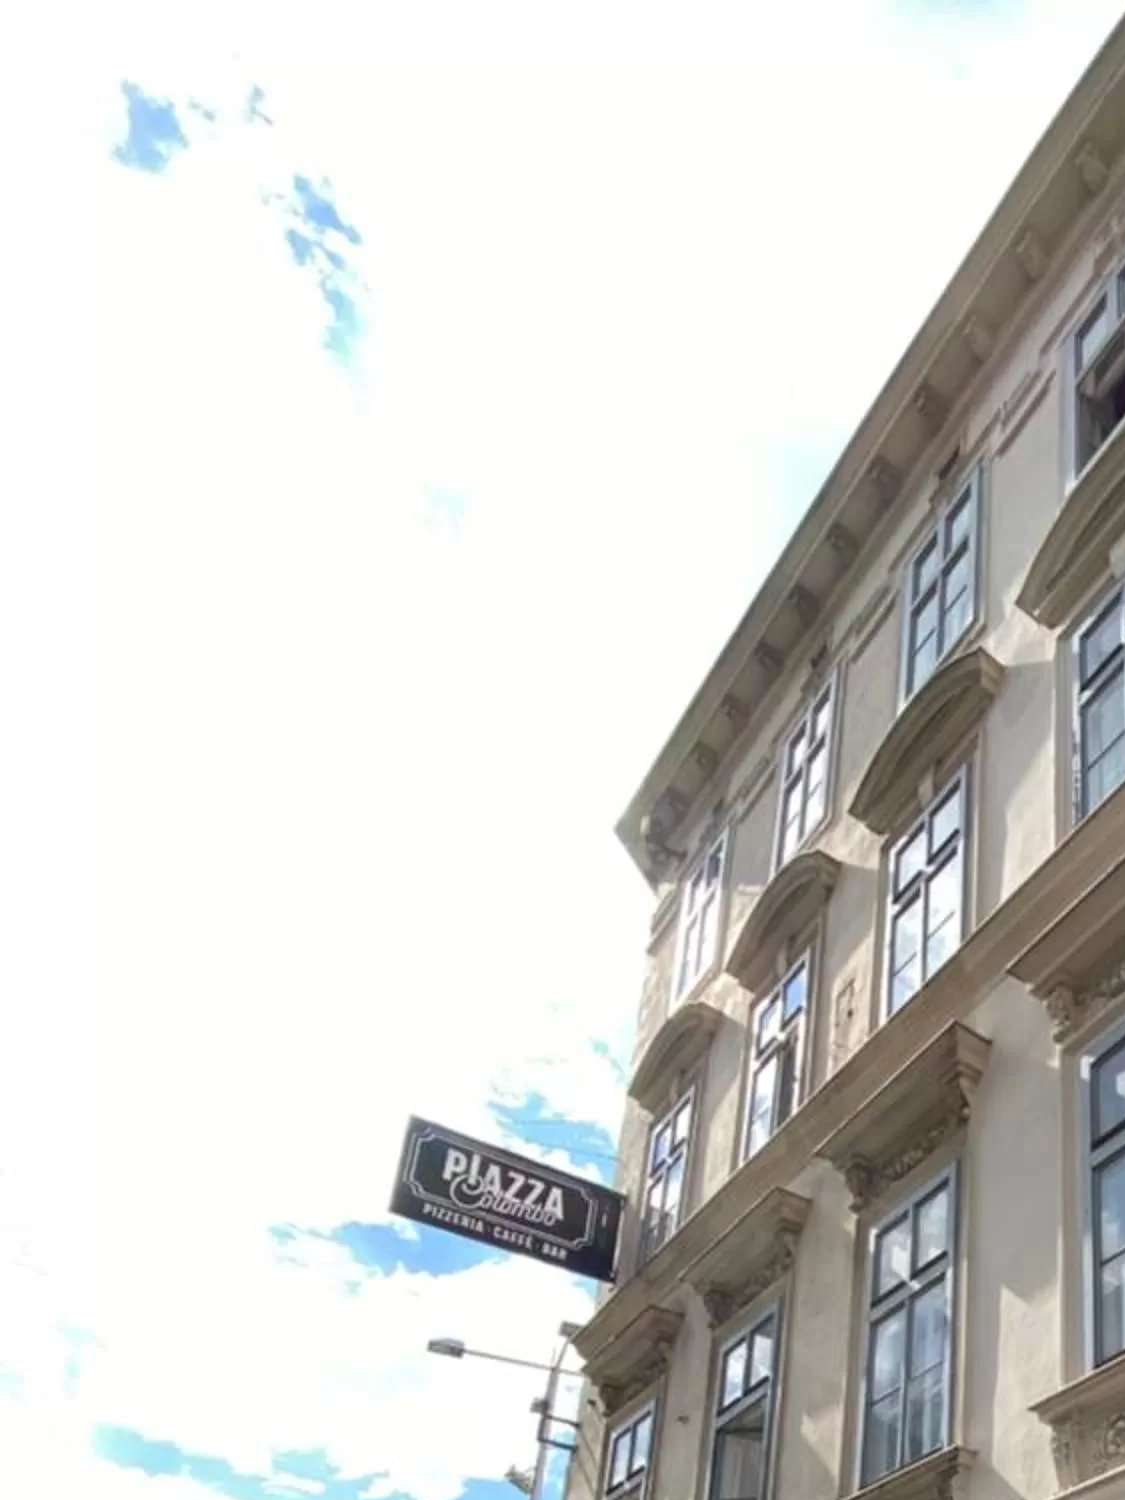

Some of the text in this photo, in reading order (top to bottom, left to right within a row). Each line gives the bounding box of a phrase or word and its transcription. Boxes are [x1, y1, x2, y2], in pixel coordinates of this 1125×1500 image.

[442, 1147, 564, 1221] PIAZZA
[449, 1173, 557, 1227] Colombo
[422, 1202, 484, 1233] PIZZERIA
[542, 1242, 567, 1260] BAR
